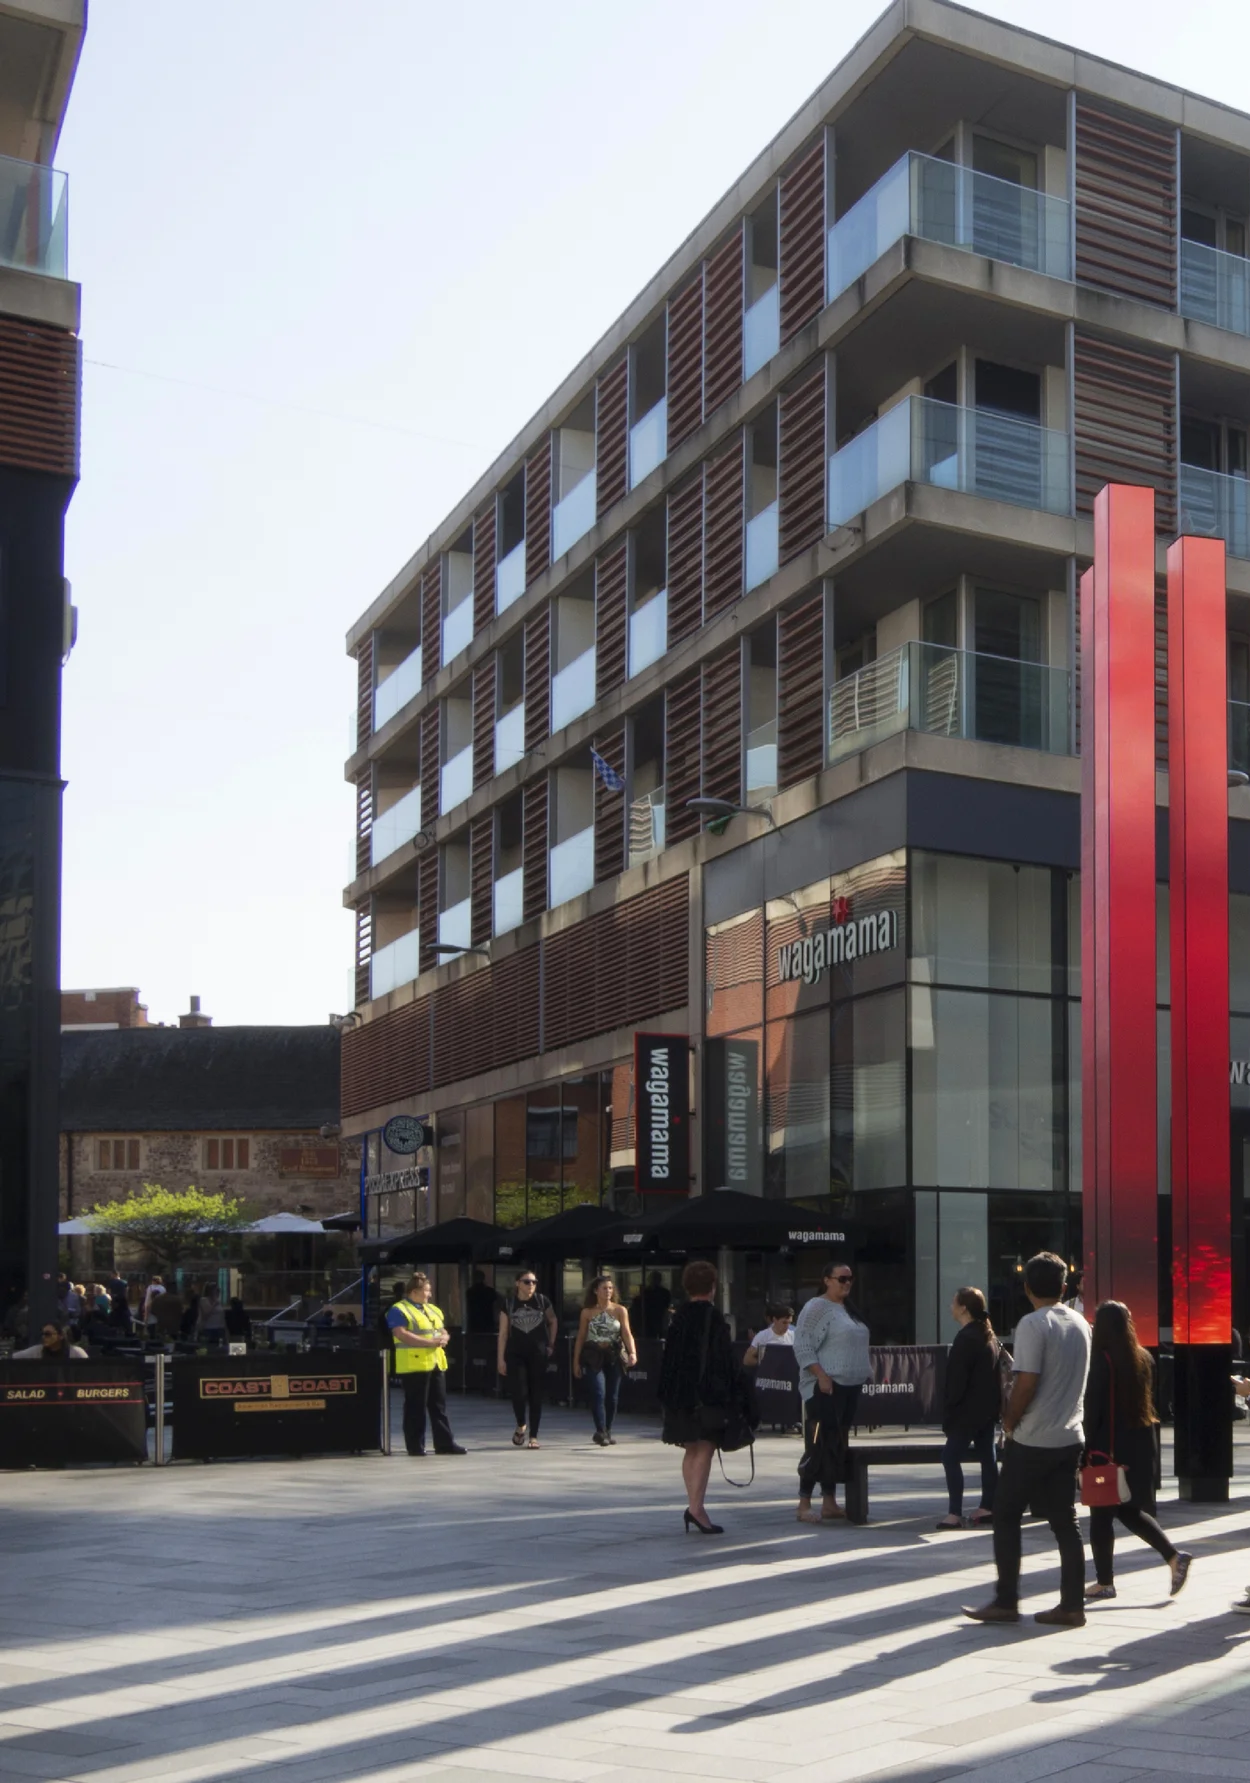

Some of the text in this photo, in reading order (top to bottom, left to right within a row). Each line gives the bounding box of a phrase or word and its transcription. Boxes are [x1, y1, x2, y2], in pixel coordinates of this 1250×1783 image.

[778, 911, 890, 984] wagamama
[645, 1048, 669, 1178] wagamama
[788, 1230, 845, 1242] wagamama
[7, 1388, 130, 1400] SALAD BURGERS
[205, 1382, 270, 1395] COAST
[290, 1379, 352, 1392] COAST
[862, 1382, 914, 1396] agamama
